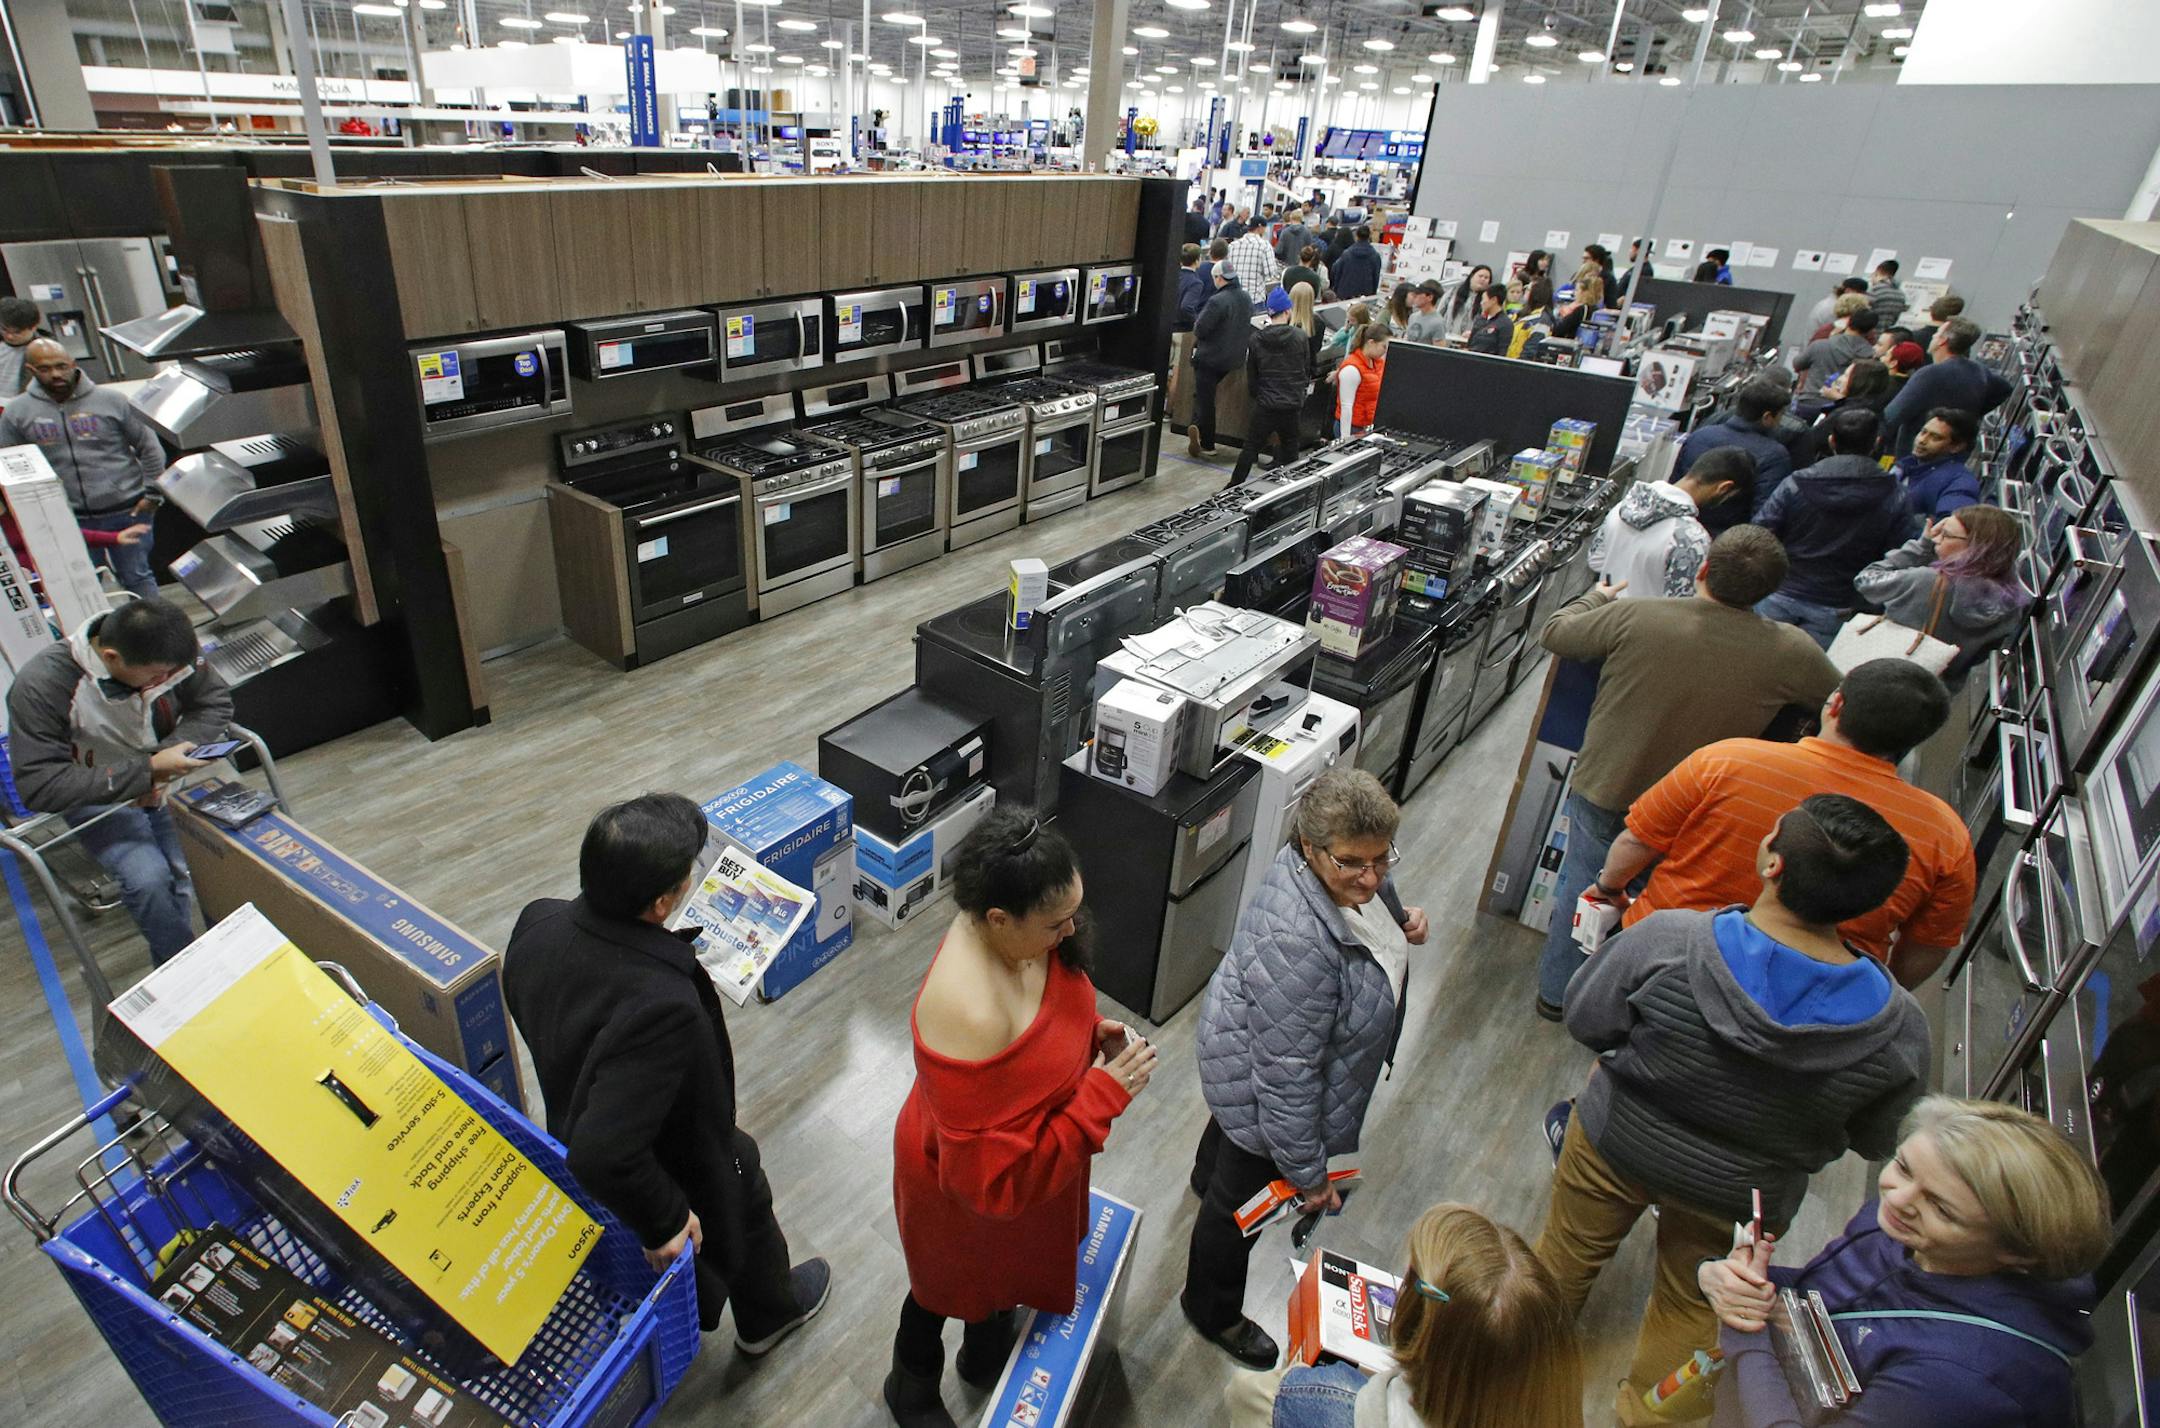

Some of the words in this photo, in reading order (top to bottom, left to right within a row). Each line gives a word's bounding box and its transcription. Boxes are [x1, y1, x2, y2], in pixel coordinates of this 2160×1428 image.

[645, 89, 654, 134] APPLIANCES
[716, 772, 799, 820] FRIGIDAIRE
[763, 820, 831, 867] FRIGIDAIRE
[718, 864, 740, 881] BUY
[720, 856, 746, 874] BEST
[391, 918, 462, 966] SAMSUNG
[685, 906, 752, 957] Doorbusters
[421, 1089, 446, 1117] 5-star
[387, 1115, 421, 1152] service
[454, 1116, 476, 1139] there
[468, 1125, 487, 1146] Free
[427, 1145, 469, 1191] shipping
[434, 1140, 454, 1164] and
[490, 1153, 516, 1182] Dyson
[409, 1161, 438, 1190] back
[495, 1161, 527, 1201] Support
[457, 1181, 493, 1223] Experts
[472, 1201, 498, 1228] from
[514, 1183, 550, 1229] warranty
[553, 1202, 573, 1226] Only
[525, 1217, 543, 1242] and
[568, 1223, 595, 1259] dyson
[1083, 1206, 1114, 1265] SAMSUNG
[504, 1239, 528, 1271] labor
[1324, 1262, 1350, 1277] SON
[496, 1274, 517, 1306] year
[1075, 1282, 1089, 1306] Full
[1350, 1275, 1368, 1334] SanDisk
[1060, 1321, 1074, 1340] TV
